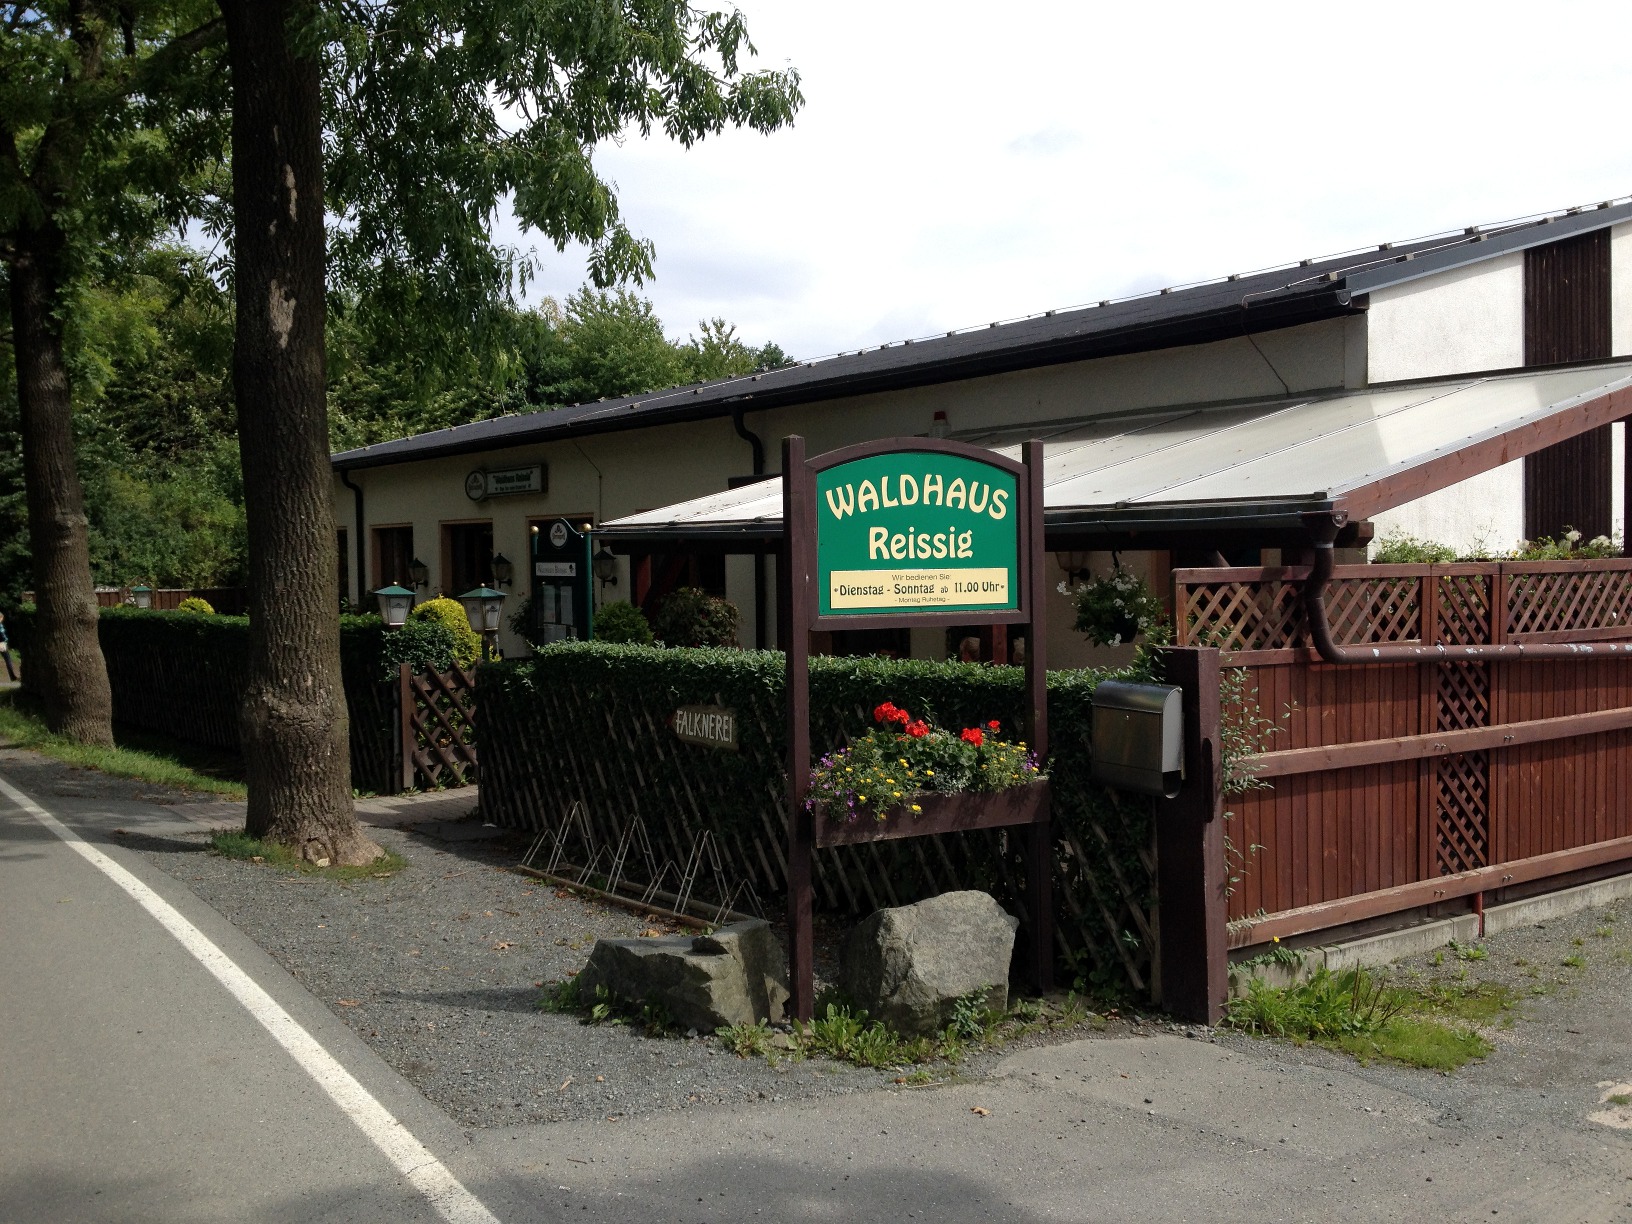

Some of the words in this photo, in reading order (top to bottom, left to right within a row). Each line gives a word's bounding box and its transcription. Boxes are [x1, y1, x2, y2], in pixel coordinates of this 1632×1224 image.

[825, 473, 1009, 520] WALDHAUS
[869, 526, 974, 560] Reissig
[839, 584, 884, 596] Dienstag
[894, 583, 935, 595] Sonntag
[940, 586, 949, 594] ab
[954, 581, 979, 593] 11.00
[981, 581, 1000, 592] Uhr
[905, 573, 938, 581] bedienen
[676, 710, 732, 743] FALKNEREI
